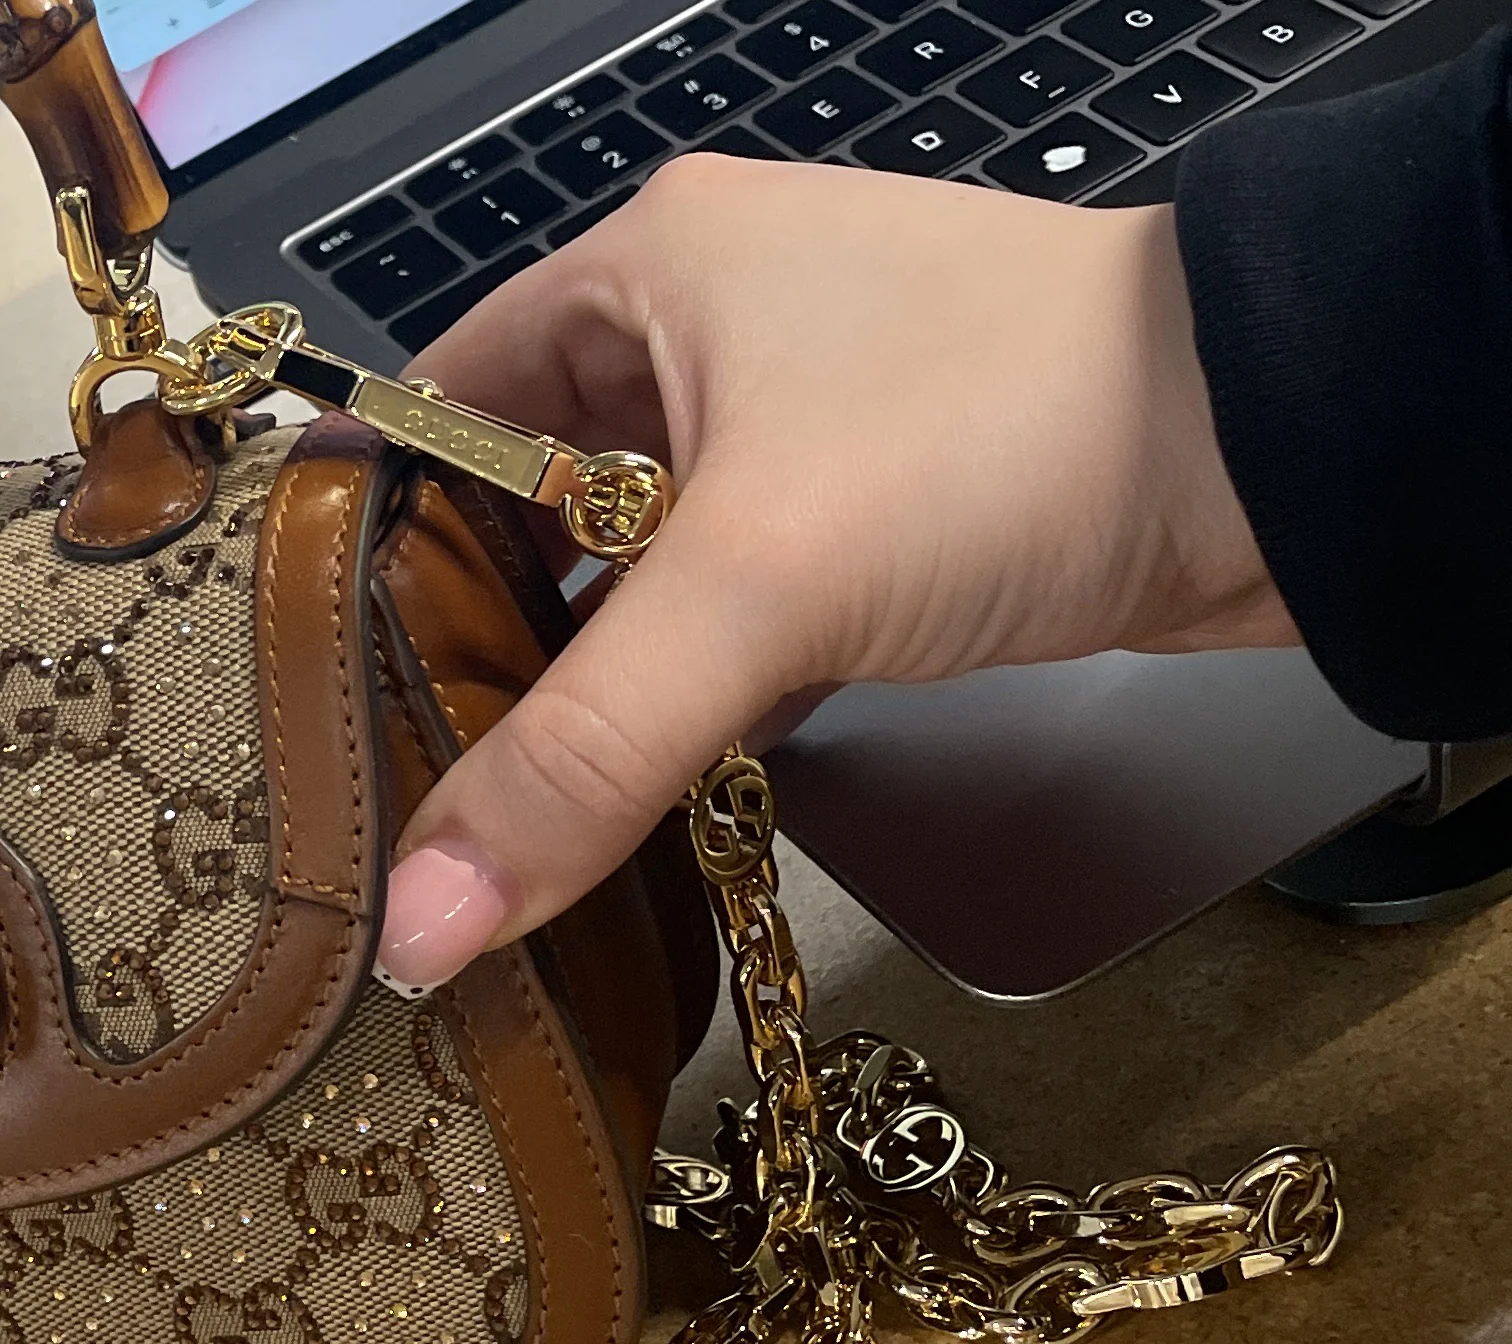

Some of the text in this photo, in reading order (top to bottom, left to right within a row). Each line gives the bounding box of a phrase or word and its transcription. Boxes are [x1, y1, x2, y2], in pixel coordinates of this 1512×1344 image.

[1124, 9, 1154, 29] G
[809, 35, 830, 52] 4
[1262, 23, 1296, 44] B
[914, 41, 944, 61] R
[1019, 69, 1044, 90] F
[703, 91, 728, 110] 3
[1152, 84, 1184, 107] V
[811, 99, 840, 120] E
[911, 130, 947, 152] D
[602, 150, 628, 169] 2
[402, 408, 509, 471] GUCCI
